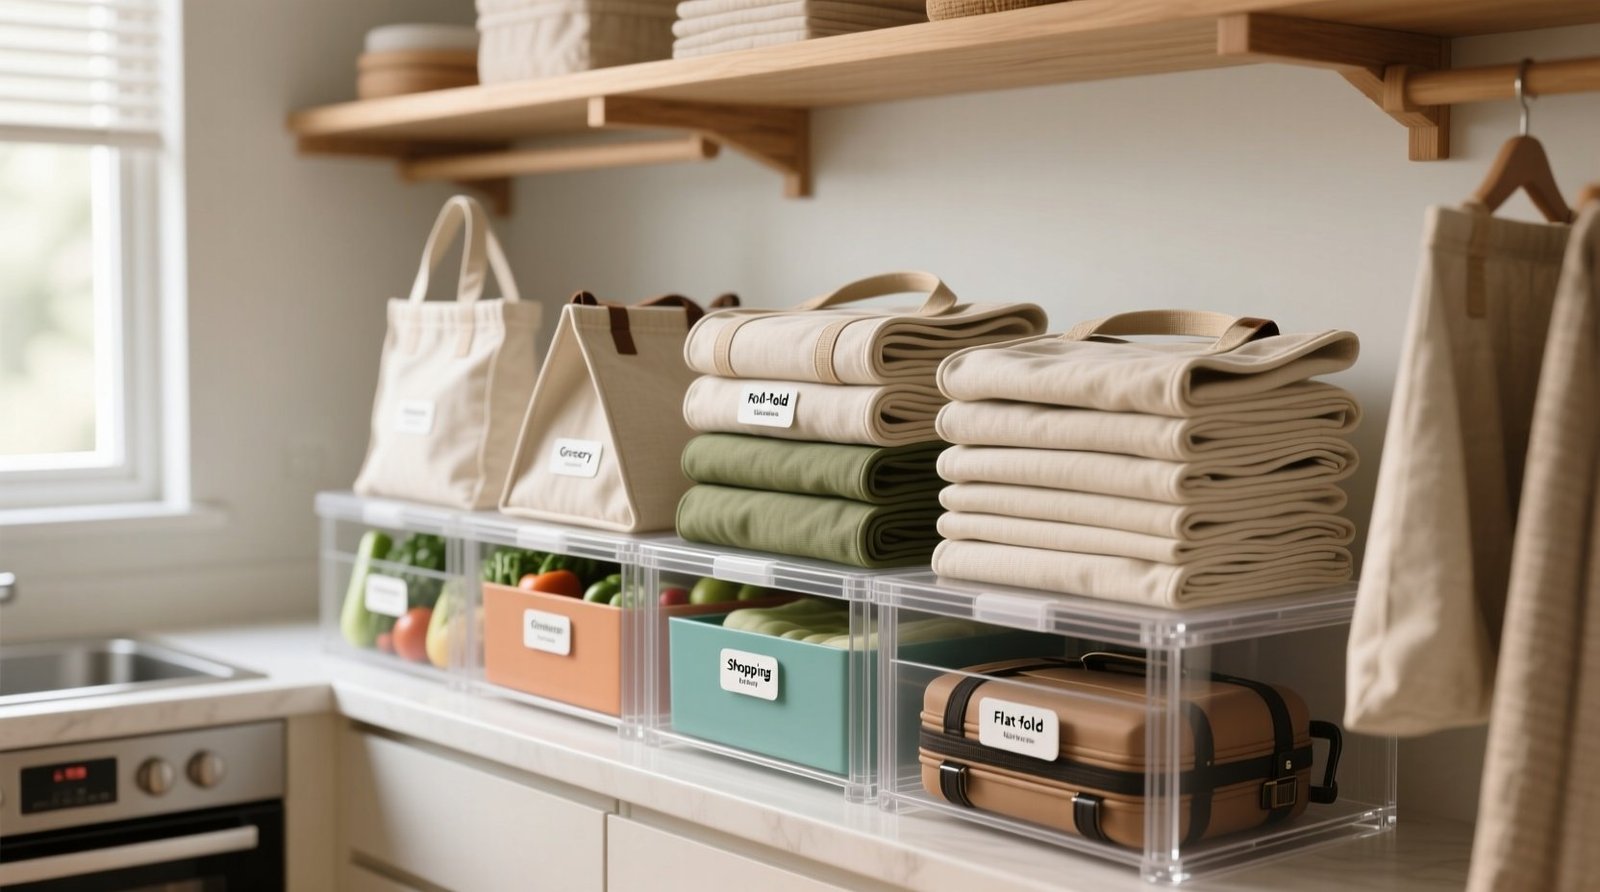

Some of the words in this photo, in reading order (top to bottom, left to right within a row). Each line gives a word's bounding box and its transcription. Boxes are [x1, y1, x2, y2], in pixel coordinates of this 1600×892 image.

[726, 658, 772, 682] Shopping
[993, 710, 1016, 728] Flat
[1017, 715, 1044, 733] fold
